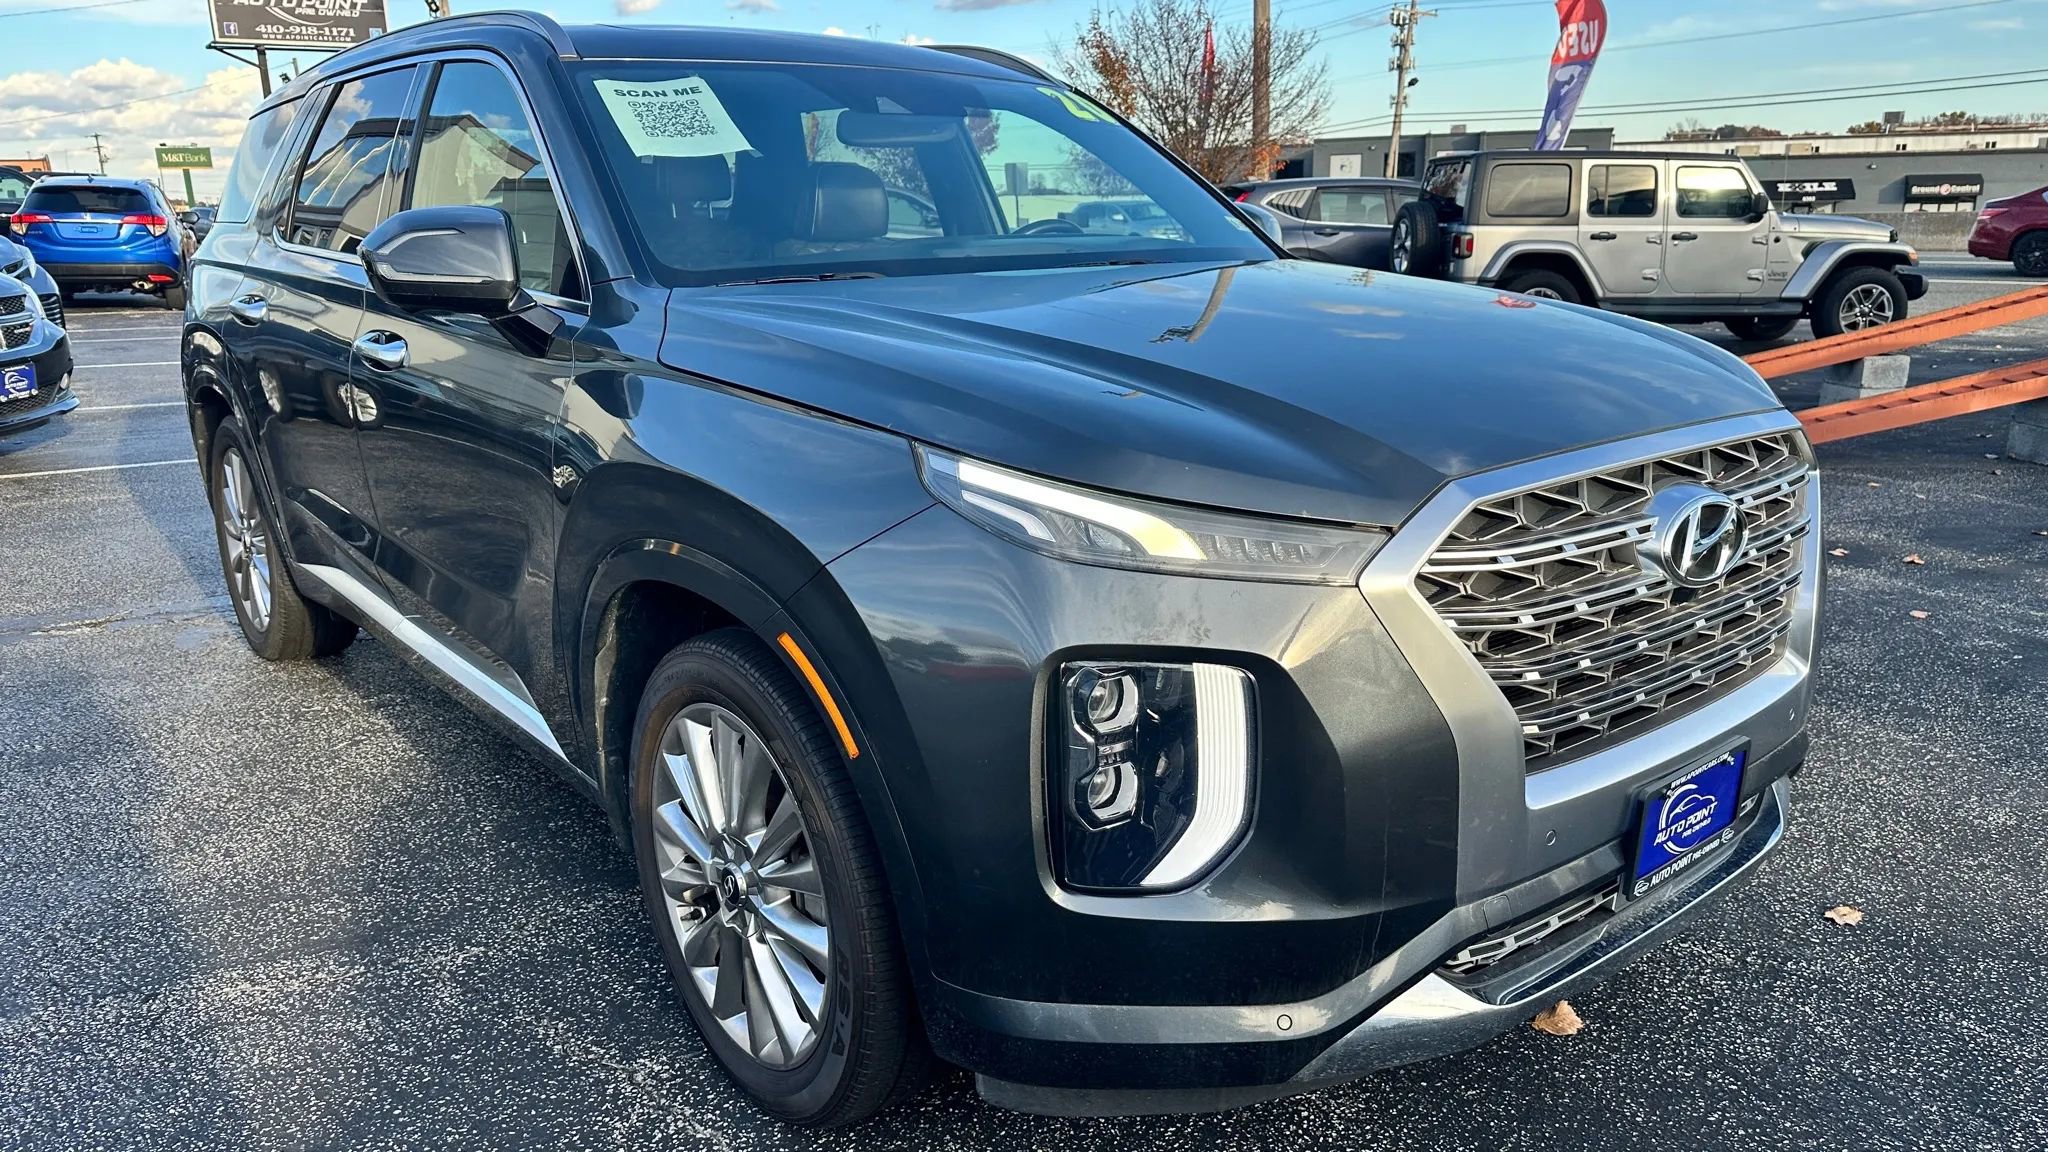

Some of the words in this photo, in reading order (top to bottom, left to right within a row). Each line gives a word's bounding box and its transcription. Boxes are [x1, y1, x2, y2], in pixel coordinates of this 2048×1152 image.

[301, 0, 368, 11] POINT
[295, 8, 316, 16] PRE
[318, 9, 360, 18] OWNED
[255, 24, 356, 37] 410-918-1171
[262, 34, 352, 42] WWW.APOINTCARS.COM
[613, 88, 668, 98] SCAN
[672, 86, 703, 96] ME
[161, 153, 184, 163] M&T
[185, 153, 208, 163] Bank
[1911, 185, 1940, 194] Ground
[1951, 184, 1980, 194] Control
[1653, 820, 1686, 847] AUTO
[1685, 801, 1719, 830] POINT
[1650, 866, 1671, 888] AUTO
[1670, 853, 1693, 875] POINT
